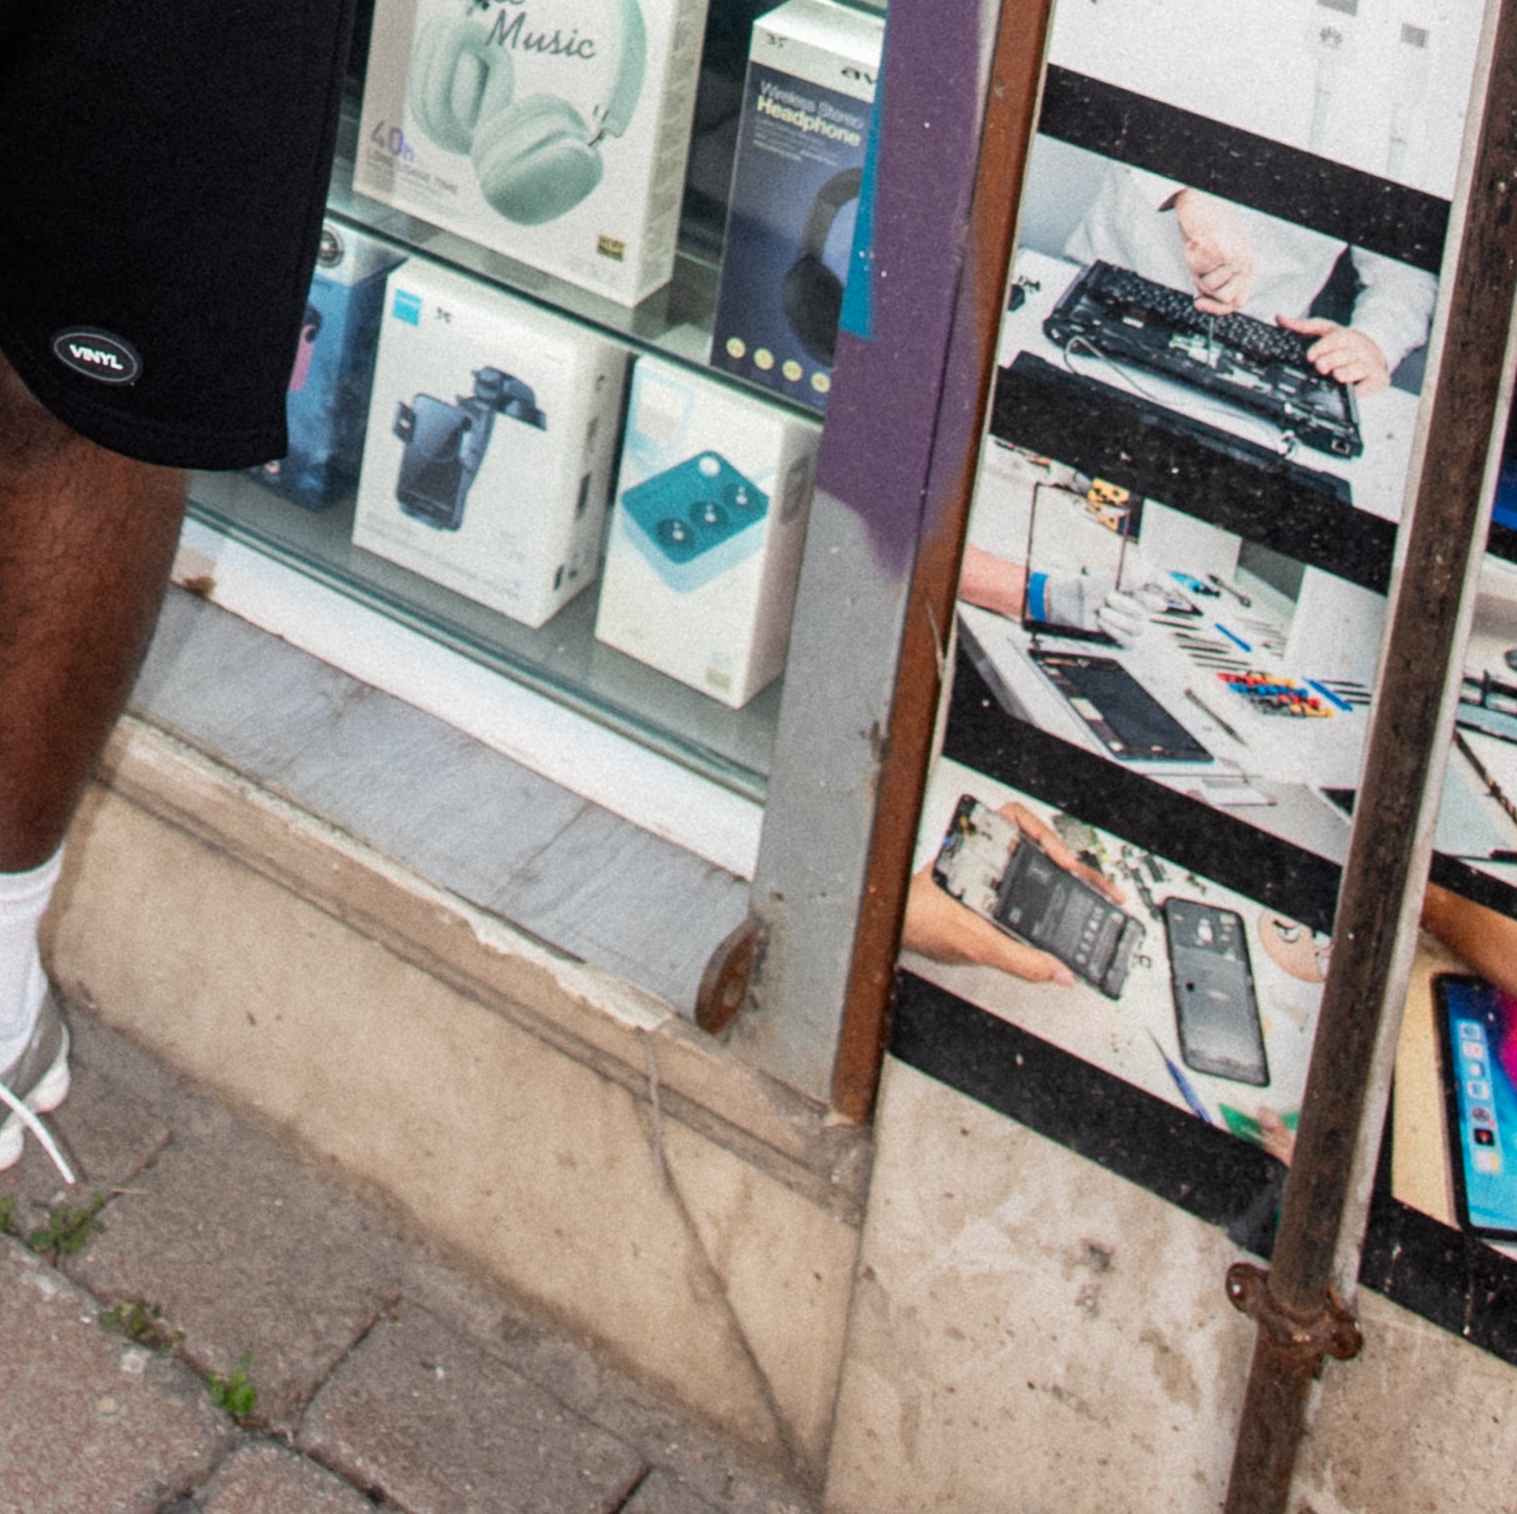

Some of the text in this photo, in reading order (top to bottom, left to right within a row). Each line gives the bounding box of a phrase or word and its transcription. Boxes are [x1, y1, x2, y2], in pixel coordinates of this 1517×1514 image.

[485, 9, 598, 61] Music
[755, 96, 862, 147] Headphone
[761, 79, 864, 131] Wireless Stereo
[70, 343, 124, 371] VINYL
